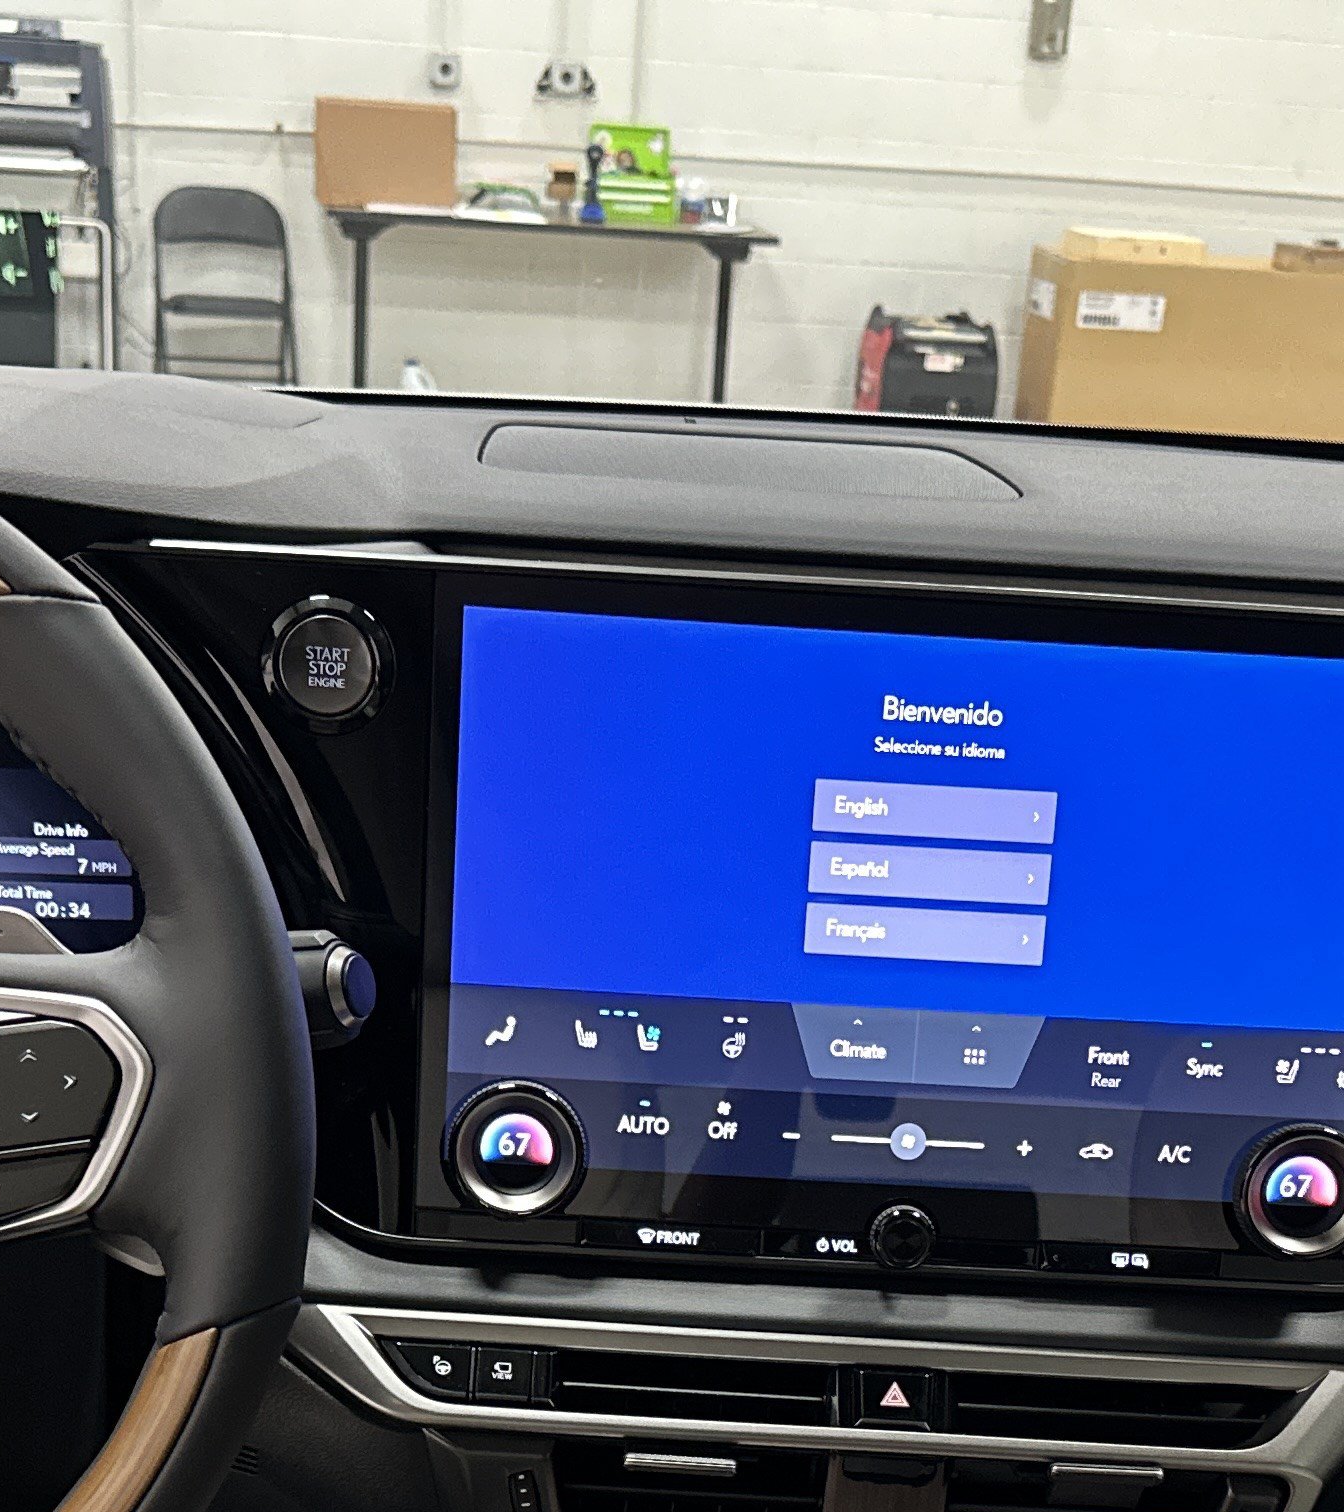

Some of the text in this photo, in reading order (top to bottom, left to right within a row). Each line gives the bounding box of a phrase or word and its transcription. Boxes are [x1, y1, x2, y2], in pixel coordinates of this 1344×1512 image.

[305, 645, 350, 662] START
[308, 662, 346, 676] STOP
[308, 676, 346, 689] ENGINE
[882, 694, 1004, 727] Bienvenido
[873, 736, 1006, 760] Seleccione su idioma
[834, 794, 889, 819] English
[33, 822, 89, 838] Drive Info
[39, 843, 75, 858] Speed
[77, 859, 117, 874] 7 MPH
[830, 856, 890, 880] Español
[24, 886, 53, 900] Time
[35, 902, 91, 918] 00:34
[825, 917, 887, 944] Français
[829, 1038, 888, 1061] Climate
[1087, 1045, 1130, 1067] Front
[1185, 1057, 1224, 1080] Sync
[1090, 1072, 1122, 1089] Rear
[616, 1115, 670, 1136] AUTO
[708, 1120, 738, 1141] Off
[497, 1131, 531, 1157] 67
[1157, 1144, 1192, 1165] A/C
[1279, 1174, 1314, 1199] 67
[656, 1229, 701, 1246] FRONT
[831, 1238, 858, 1253] VOL
[491, 1371, 513, 1381] VIEW
